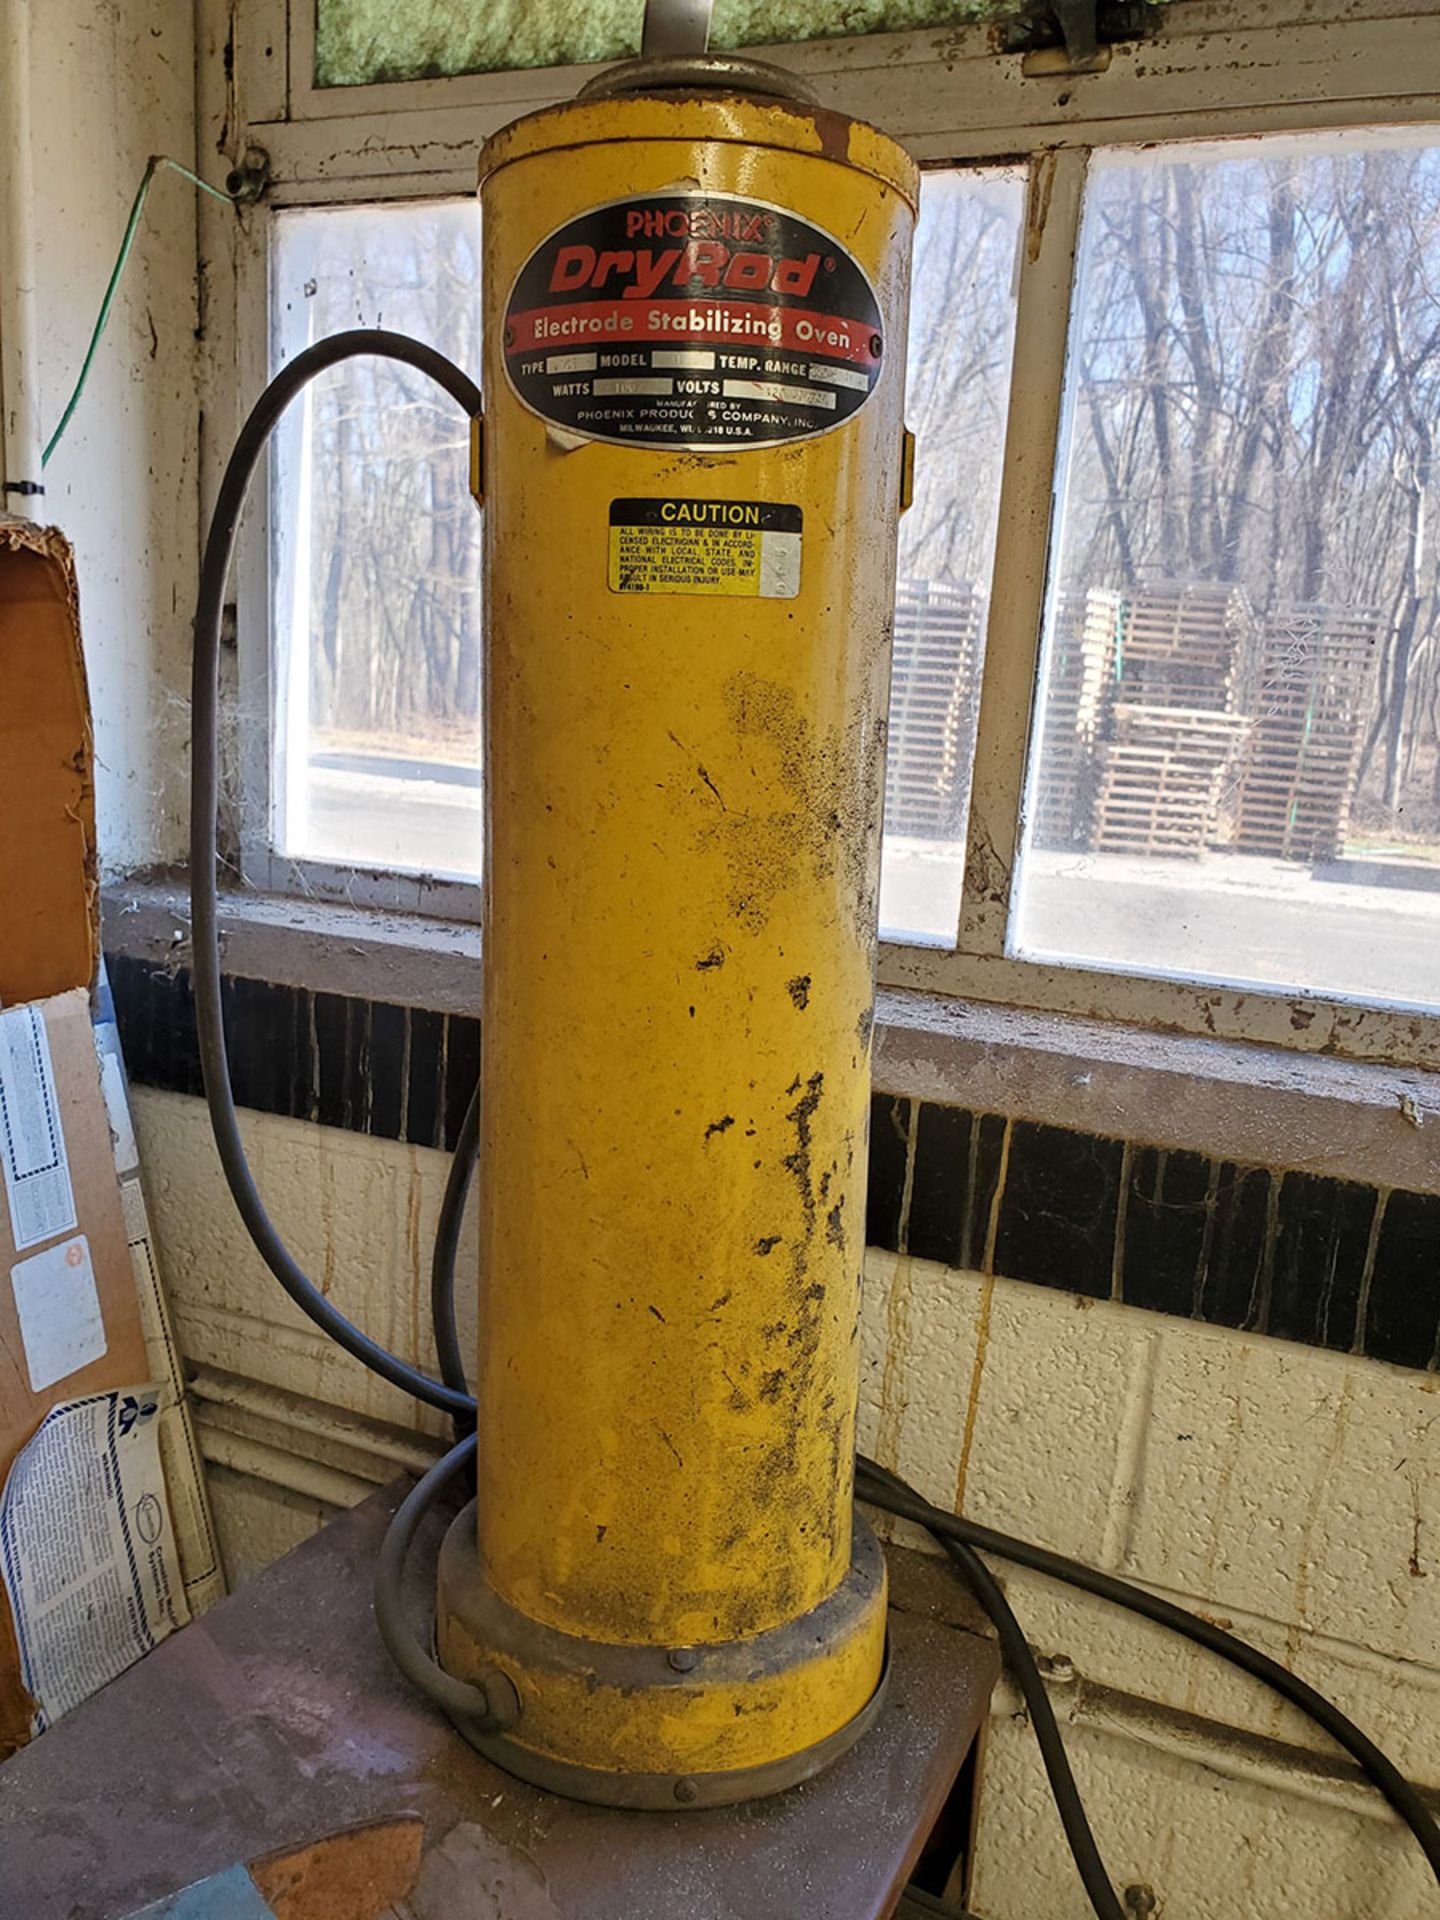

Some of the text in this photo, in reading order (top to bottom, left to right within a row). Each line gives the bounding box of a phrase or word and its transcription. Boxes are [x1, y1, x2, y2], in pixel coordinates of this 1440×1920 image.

[534, 308, 850, 349] Electrode Stabilizing Oven
[521, 361, 545, 375] TYPE
[601, 354, 647, 367] MODEL
[720, 355, 761, 371] TEMP.
[765, 360, 807, 377] RANGE
[553, 383, 590, 397] WATTS
[677, 380, 720, 395] VOLTS
[729, 402, 741, 410] BY
[577, 409, 817, 429] PHOENIX PRODUCS COMPANY, INC.
[619, 423, 678, 434] MILWAUKEE,
[725, 426, 753, 436] U.S.A.
[661, 503, 760, 524] CAUTION
[638, 528, 665, 536] WIRING
[669, 528, 677, 536] IS
[681, 528, 691, 537] TO
[695, 529, 704, 537] BE
[708, 529, 729, 538] DONE
[733, 530, 742, 538] BY
[619, 536, 649, 545] CENSED
[652, 537, 699, 546] ELECTRICIAN
[723, 540, 755, 549] ACCORD-
[620, 546, 641, 554] ANCE
[739, 550, 756, 558] AND
[620, 555, 656, 563] NATIONAL
[662, 556, 704, 565] ELECTRICAL
[620, 565, 756, 577] PROPER INSTALLATION OR USE MAY
[660, 574, 691, 583] SERIOUS
